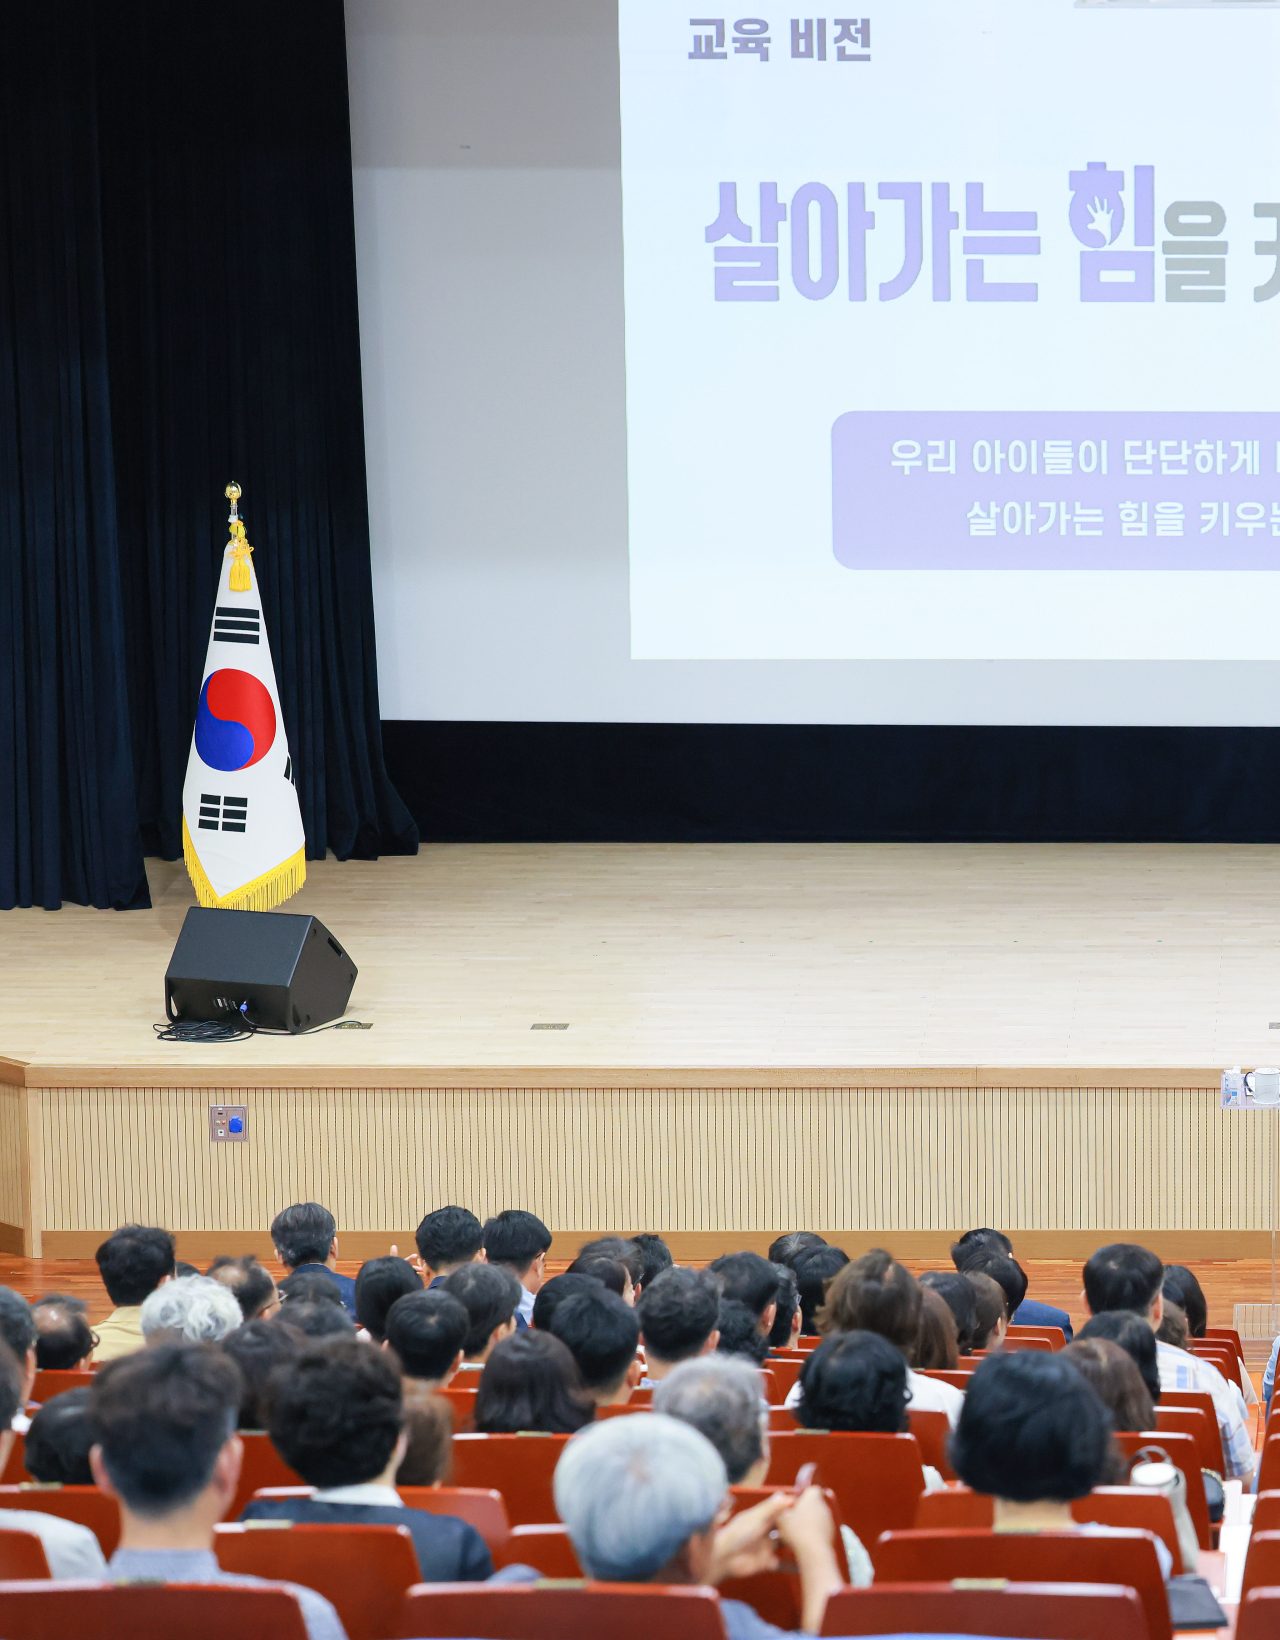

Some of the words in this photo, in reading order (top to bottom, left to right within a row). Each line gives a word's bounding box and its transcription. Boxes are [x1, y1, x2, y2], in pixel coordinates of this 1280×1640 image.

[688, 18, 771, 62] 교육
[790, 18, 871, 61] 비전
[705, 182, 1041, 302] 살아가는
[1069, 162, 1228, 302] 힘을
[890, 440, 956, 476] 우리
[972, 440, 1107, 474] 아이들이
[1122, 439, 1260, 475] 단단하게
[966, 502, 1104, 536] 살아가는
[1119, 501, 1185, 537] 힘을
